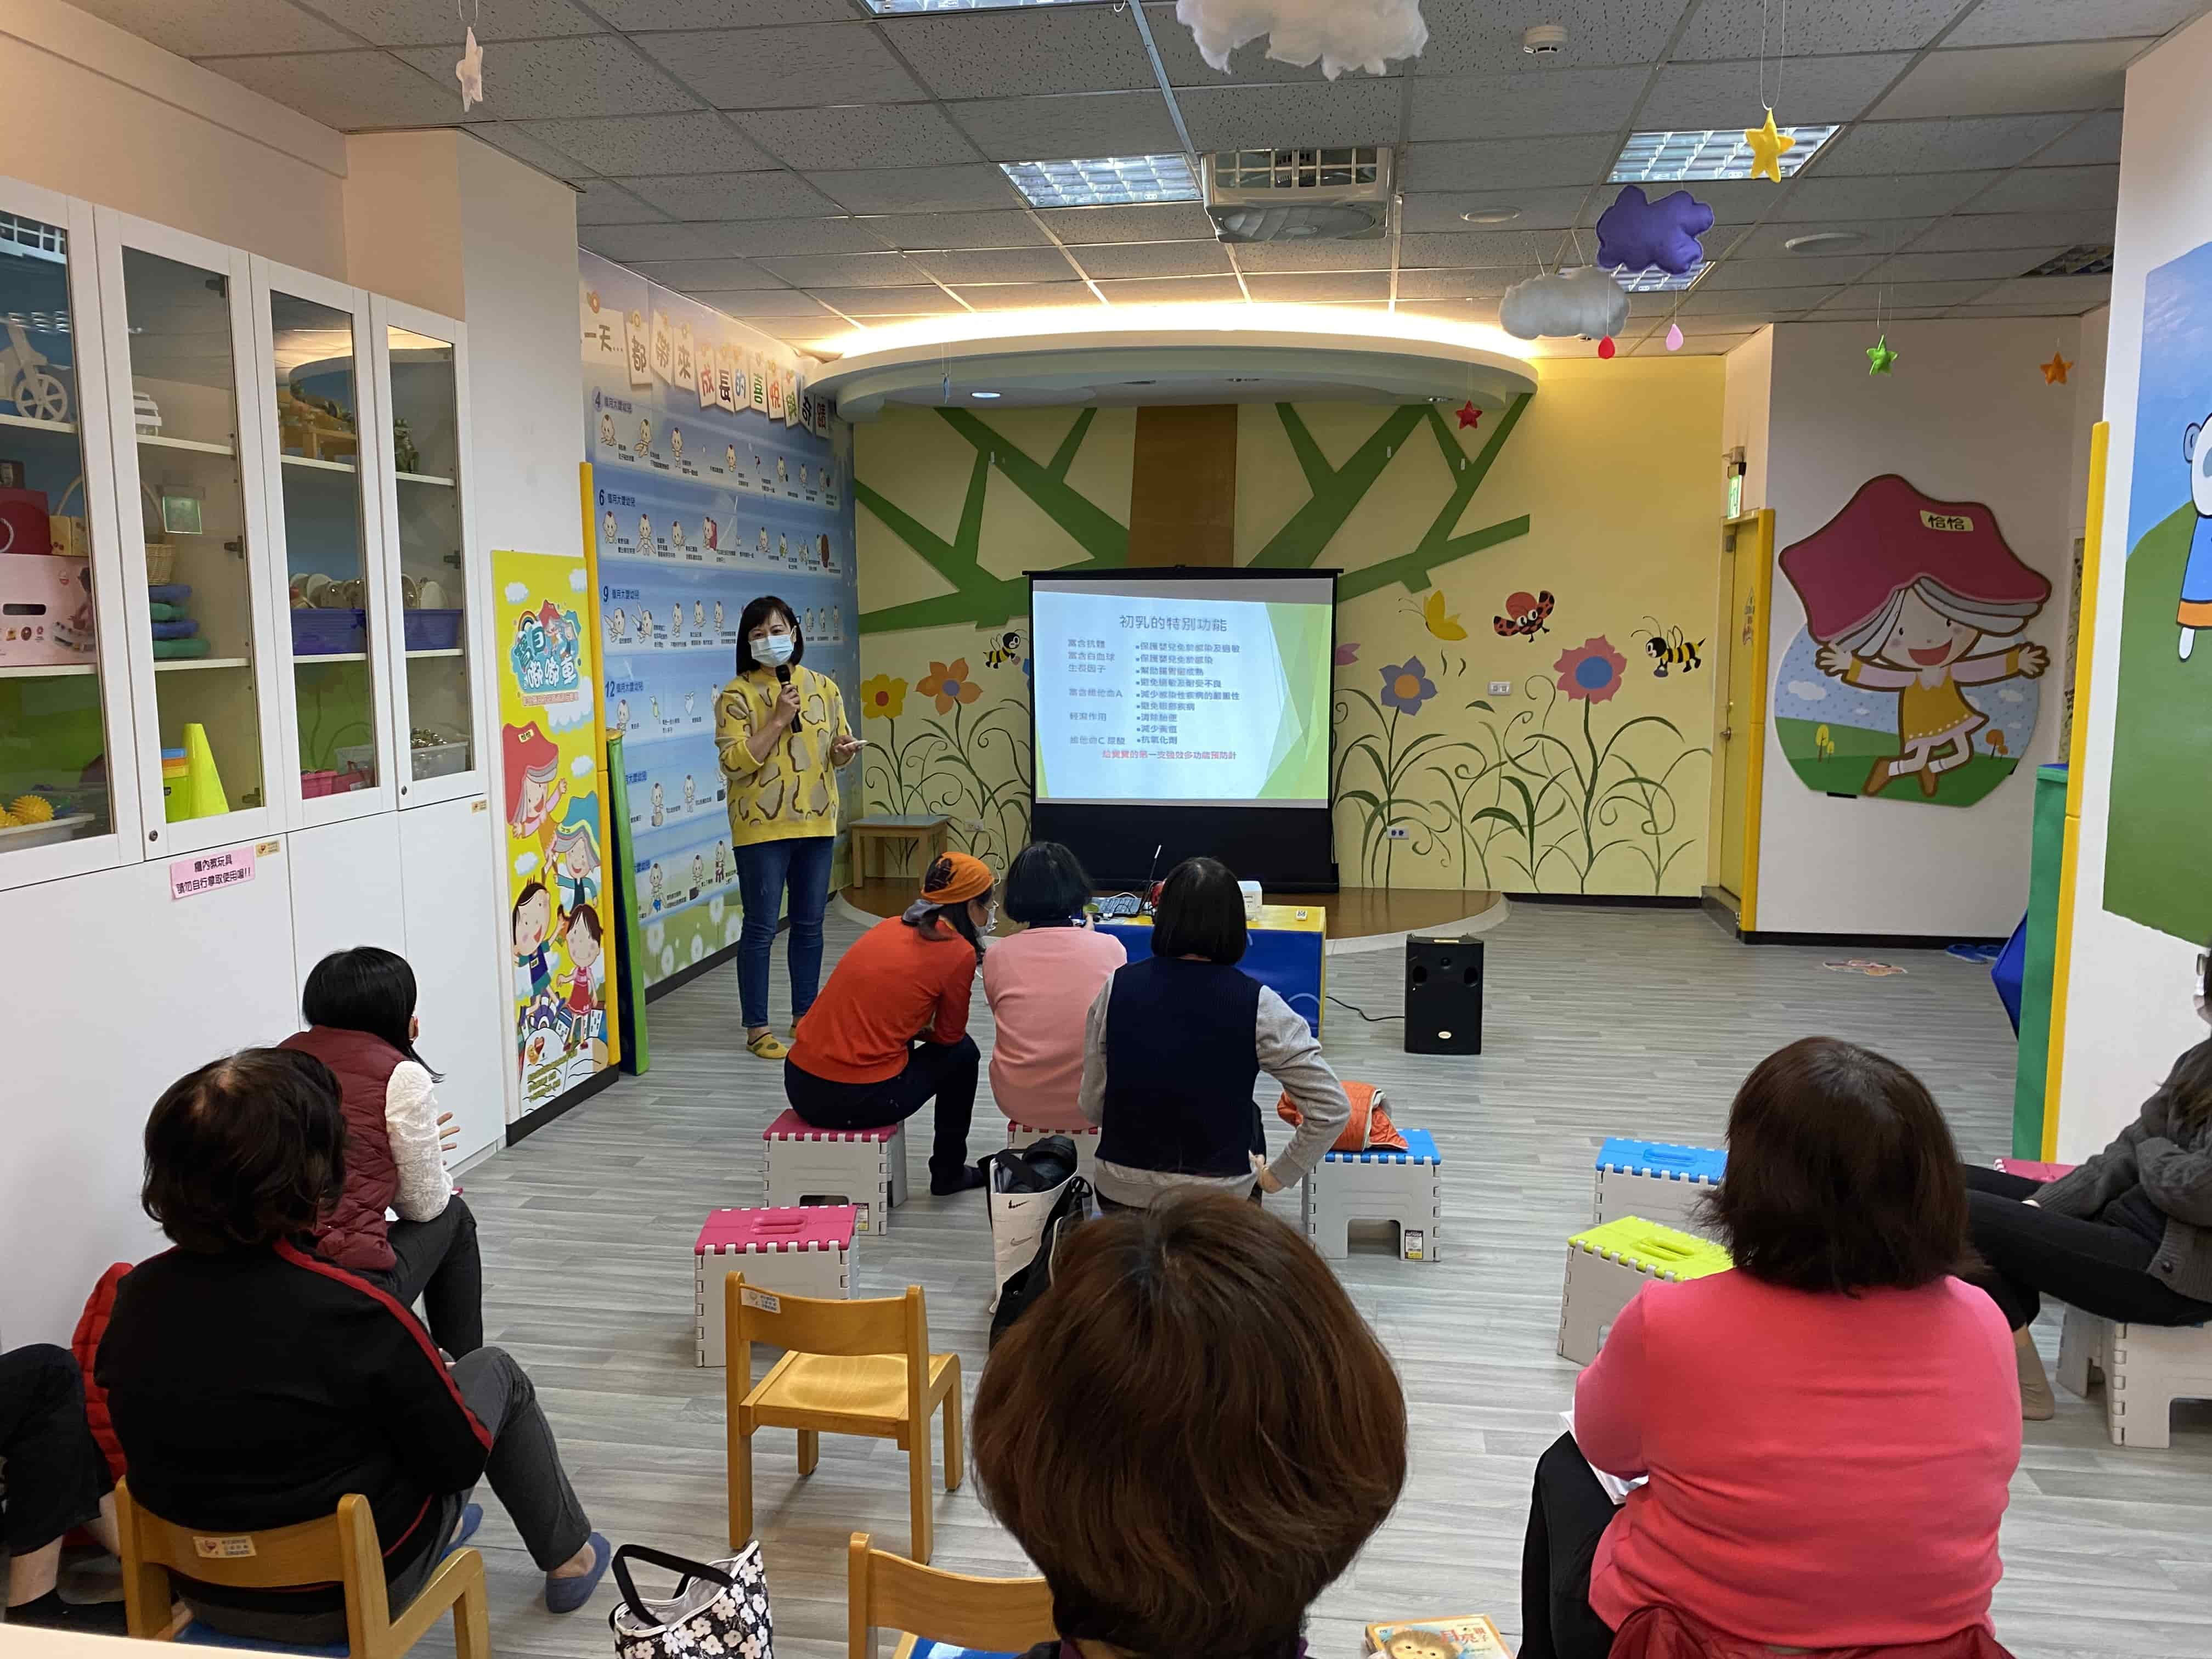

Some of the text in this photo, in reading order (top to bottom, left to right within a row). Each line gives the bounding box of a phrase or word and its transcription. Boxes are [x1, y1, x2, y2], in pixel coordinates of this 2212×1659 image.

[595, 391, 601, 408] 4
[599, 489, 605, 506] 6
[603, 585, 608, 602] 9
[1119, 614, 1228, 632] 初乳的特別功能
[1068, 651, 1115, 662] 富含白血球
[1068, 664, 1107, 674] 生長因子
[605, 680, 615, 698] 12
[1141, 736, 1178, 745] 抗氧化劑
